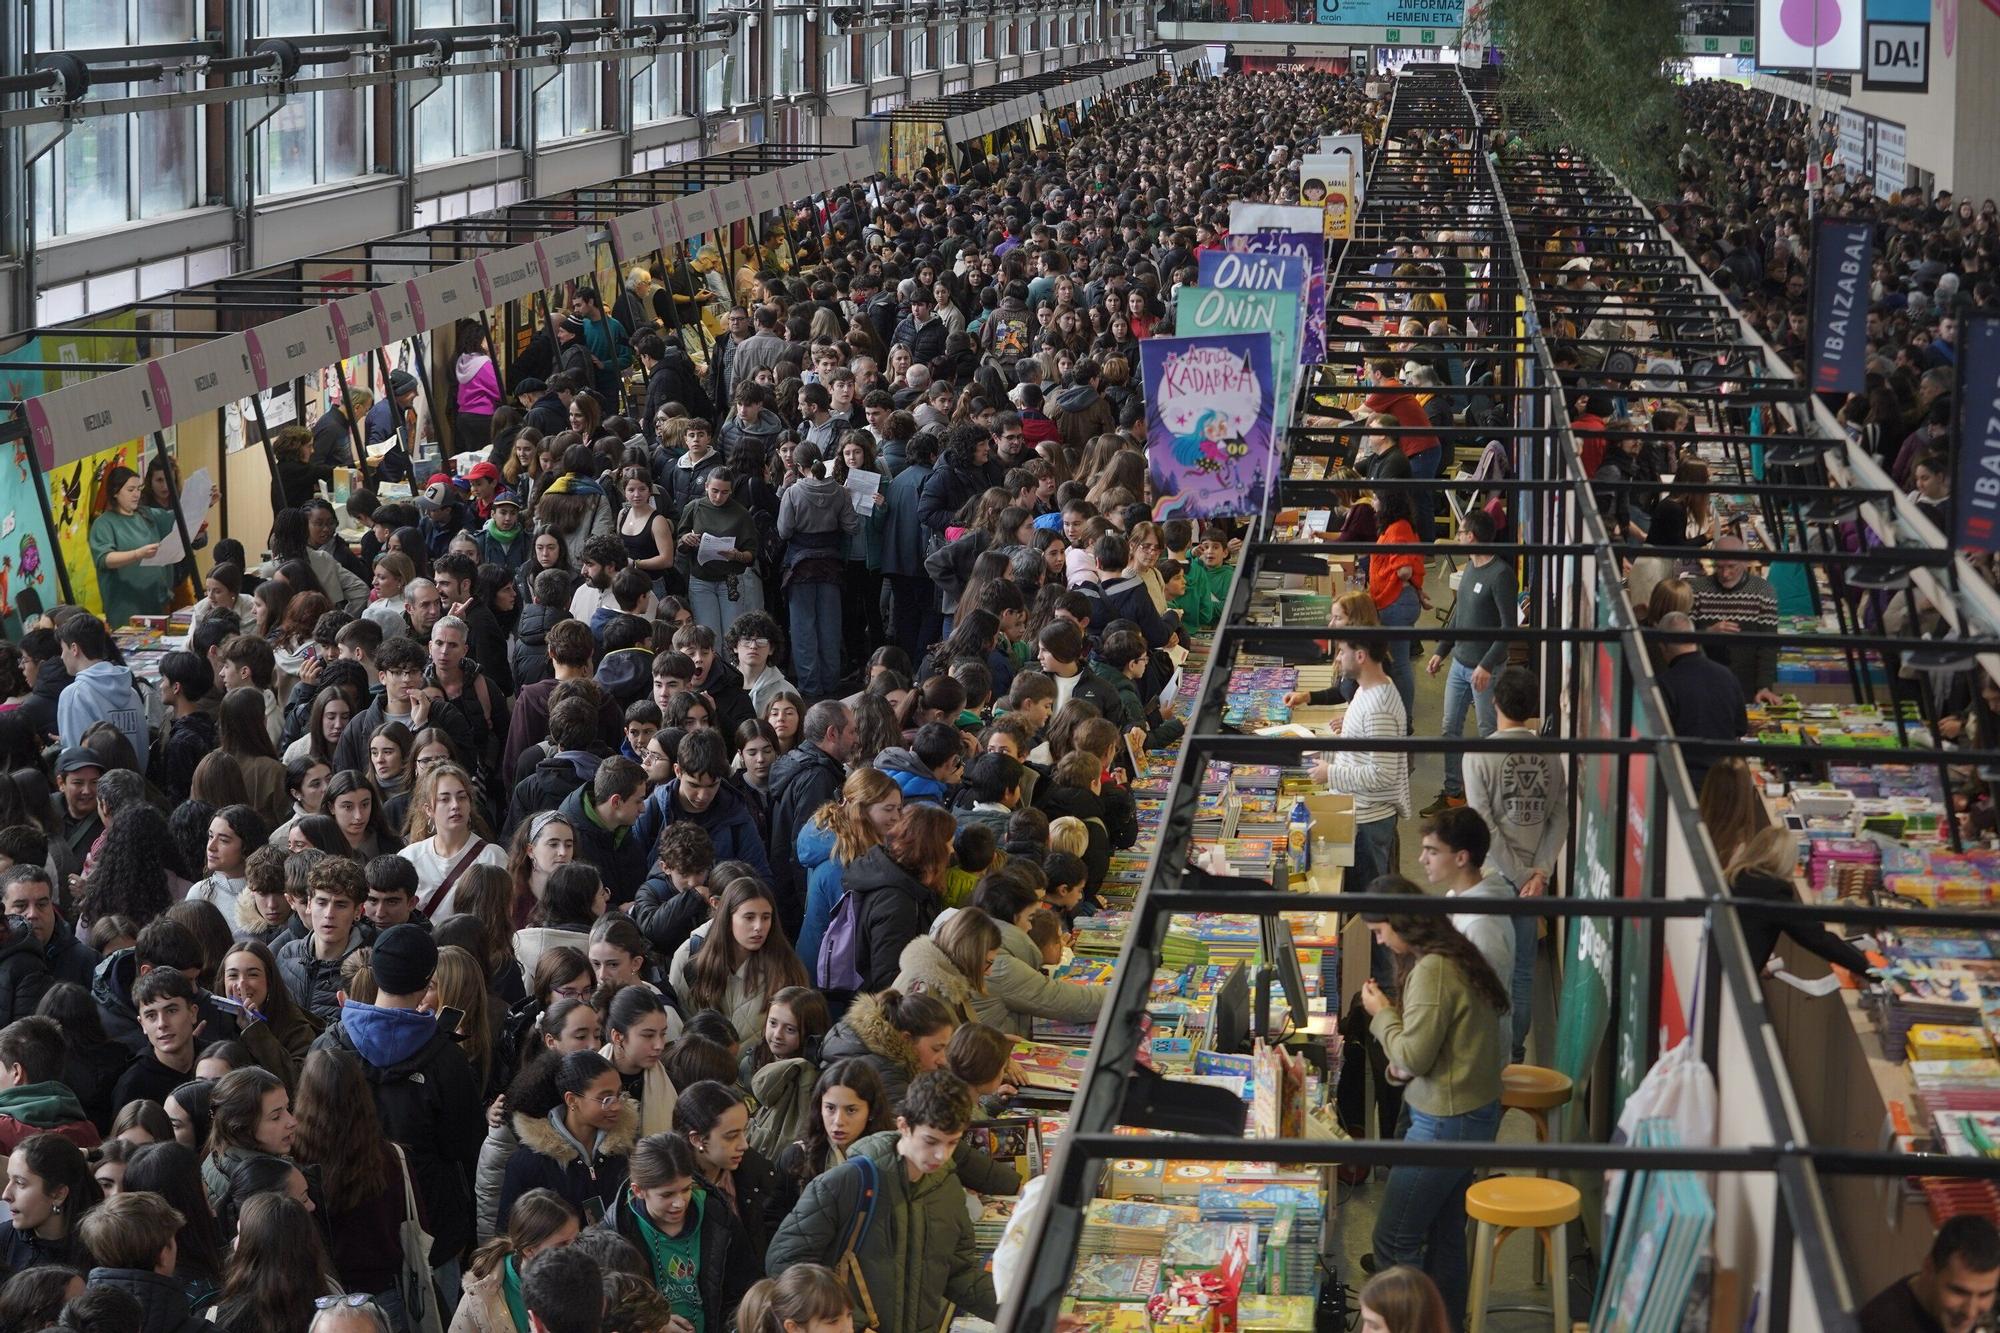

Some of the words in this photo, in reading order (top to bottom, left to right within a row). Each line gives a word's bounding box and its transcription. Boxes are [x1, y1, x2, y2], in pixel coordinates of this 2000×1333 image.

[1398, 0, 1464, 10] INFORMAZ
[1387, 12, 1430, 22] HEMEN
[1432, 13, 1454, 23] ETA
[1874, 40, 1919, 68] DA!
[1276, 63, 1305, 72] ZETAK
[1822, 228, 1868, 361] IBAIZABAL
